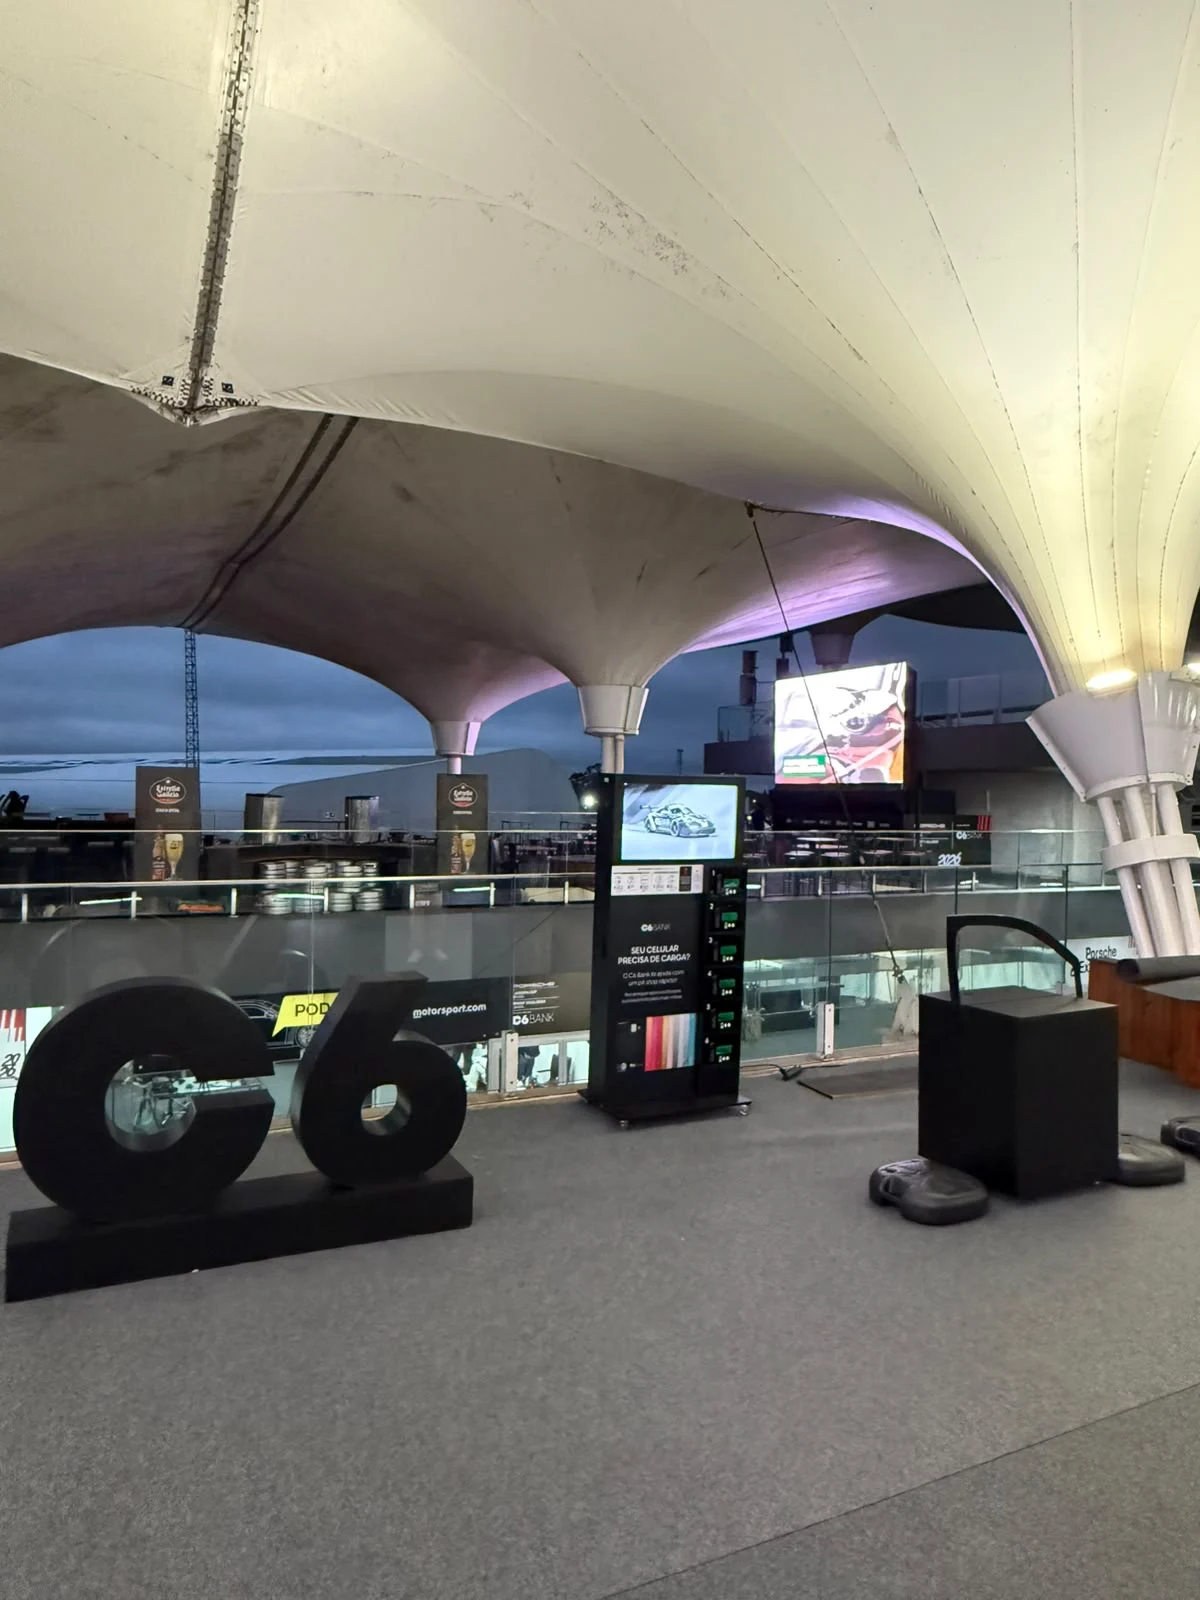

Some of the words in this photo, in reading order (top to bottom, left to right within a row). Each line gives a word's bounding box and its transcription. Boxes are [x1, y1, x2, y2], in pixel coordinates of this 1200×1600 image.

[938, 852, 962, 867] 2026
[640, 924, 653, 932] C6
[630, 946, 645, 955] SEU
[646, 944, 680, 954] CELULAR
[1085, 945, 1117, 959] Porsche
[617, 955, 649, 965] PRECISA
[650, 954, 660, 963] DE
[661, 952, 691, 962] CARGA?
[295, 1002, 330, 1017] POD
[413, 1003, 487, 1019] motorsport.com
[529, 1012, 555, 1024] BANK
[13, 970, 468, 1224] C6
